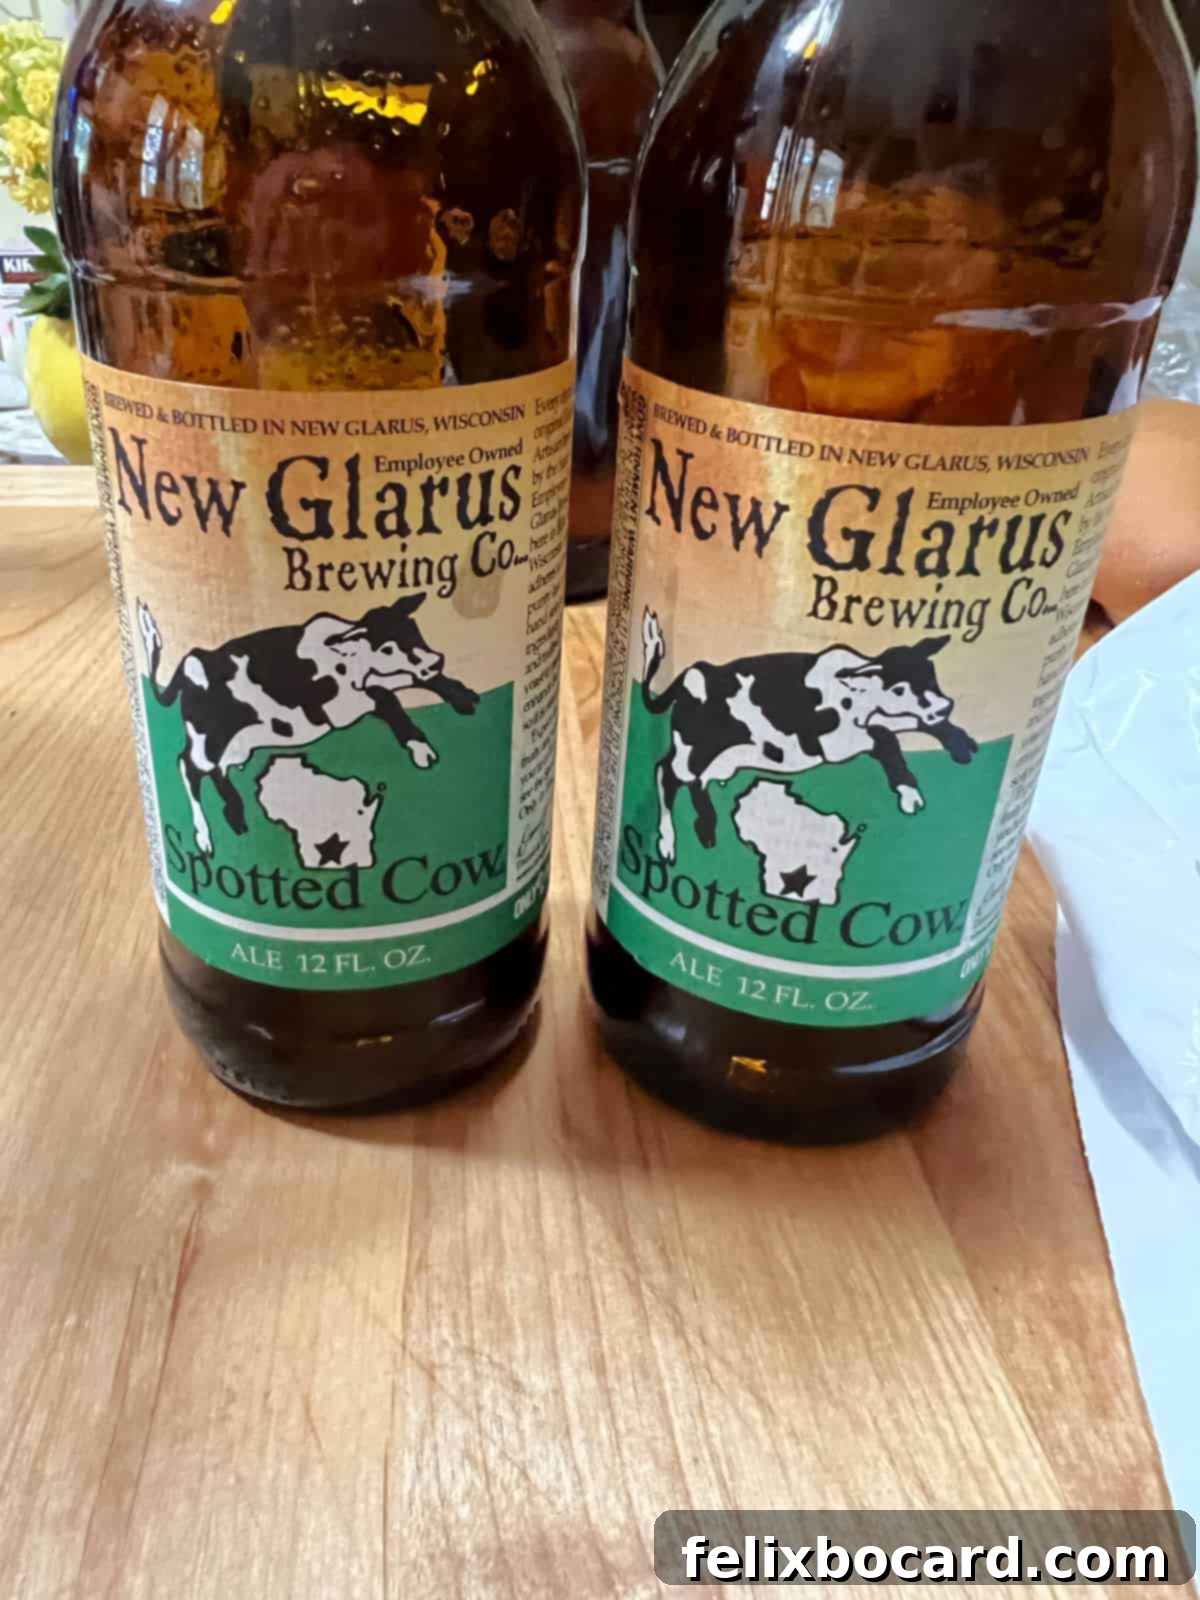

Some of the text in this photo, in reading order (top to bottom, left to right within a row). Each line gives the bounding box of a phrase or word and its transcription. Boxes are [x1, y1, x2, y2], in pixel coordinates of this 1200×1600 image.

[103, 390, 154, 419] BREWED
[157, 407, 169, 423] &
[172, 409, 257, 435] BOTTLED
[263, 419, 285, 435] IN
[291, 420, 340, 436] NEW
[345, 417, 429, 436] GLARUS,
[433, 404, 526, 431] WISCONSIN
[653, 403, 707, 435] BREWED
[710, 424, 722, 441] &
[726, 427, 815, 459] BOTTLED
[819, 444, 844, 463] IN
[848, 449, 900, 468] NEW
[904, 454, 990, 474] GLARUS,
[997, 446, 1090, 471] WISCONSIN
[108, 427, 247, 538] New
[265, 453, 522, 541] Glarus
[374, 453, 465, 477] Employee
[468, 438, 523, 464] Owned
[645, 438, 790, 559] New
[807, 484, 1072, 578] Glarus
[927, 491, 1021, 516] Employee
[1024, 482, 1081, 506] Owned
[282, 543, 458, 599] Brewing
[806, 574, 990, 642] Brewing
[165, 823, 363, 910] Spotted
[621, 824, 819, 944] Spotted
[231, 942, 431, 974] ALE 12 FL. OZ.
[670, 951, 873, 1011] ALE 12 FL. OZ.
